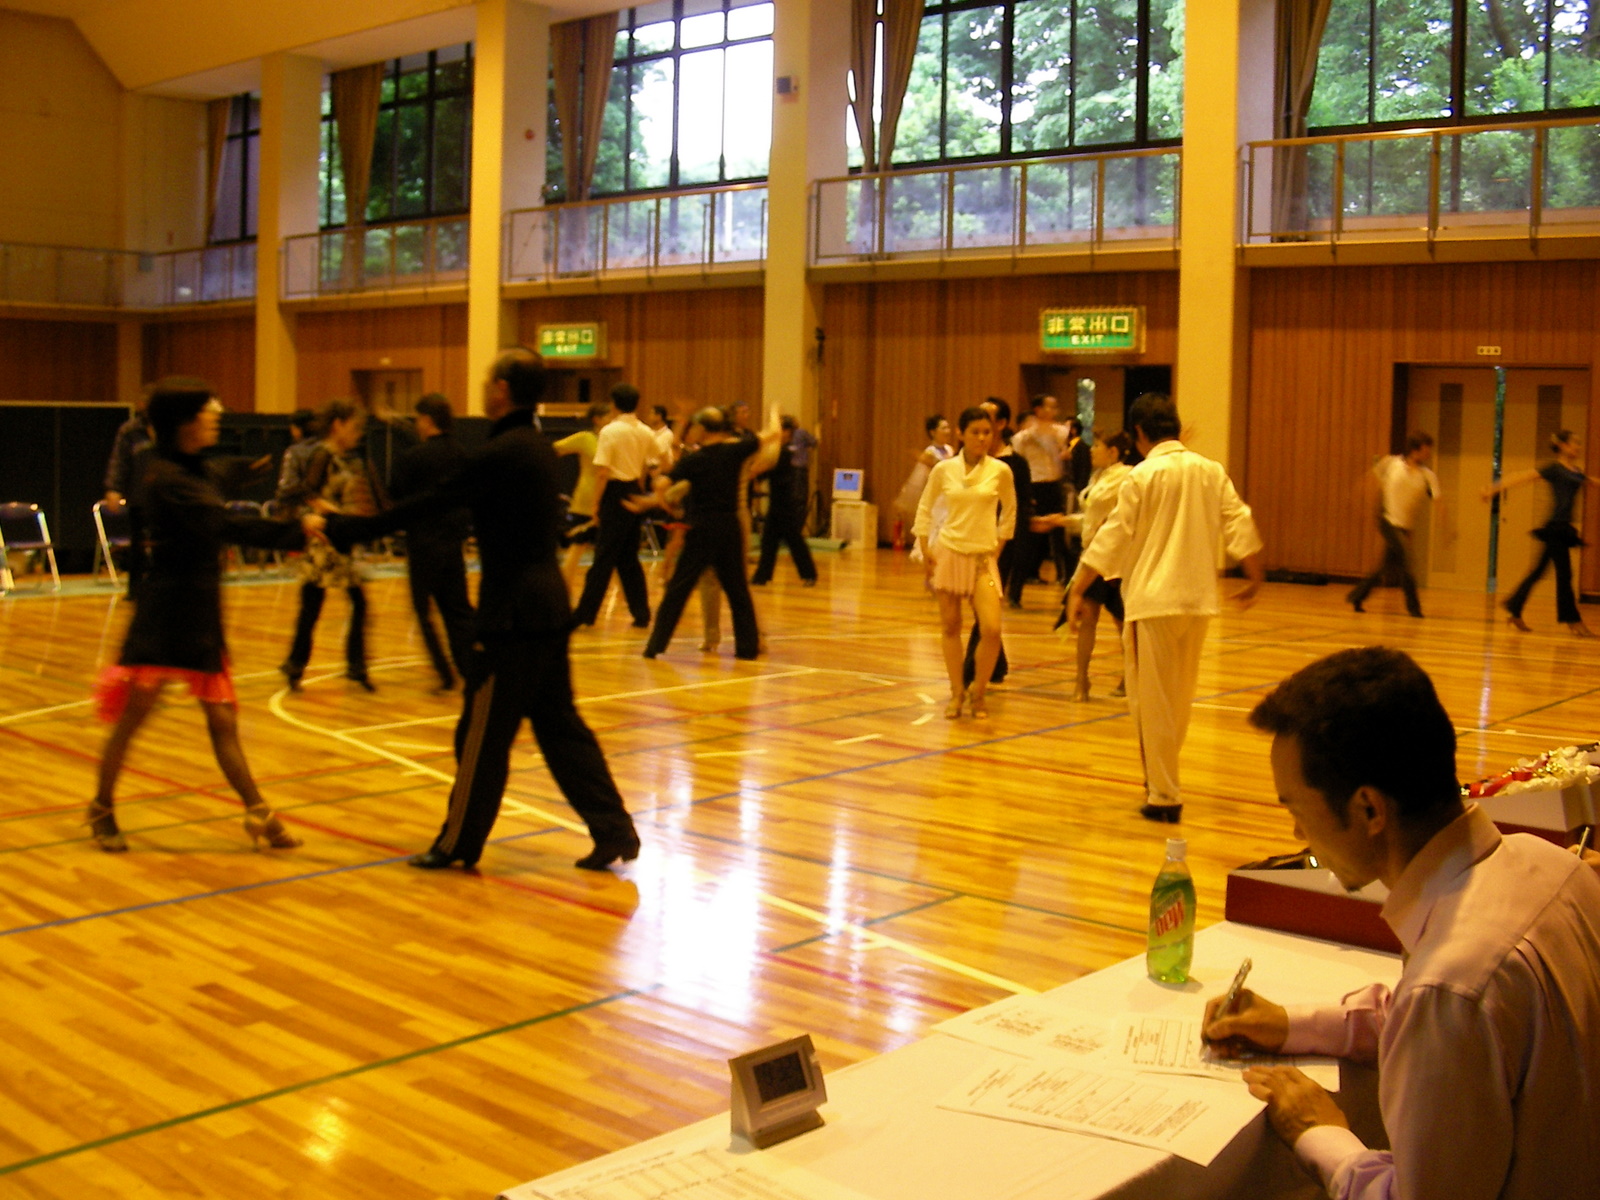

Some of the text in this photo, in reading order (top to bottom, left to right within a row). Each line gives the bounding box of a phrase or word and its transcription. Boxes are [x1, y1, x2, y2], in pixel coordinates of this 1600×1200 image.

[1047, 315, 1129, 333] 非常出口
[1071, 335, 1104, 345] EXIT
